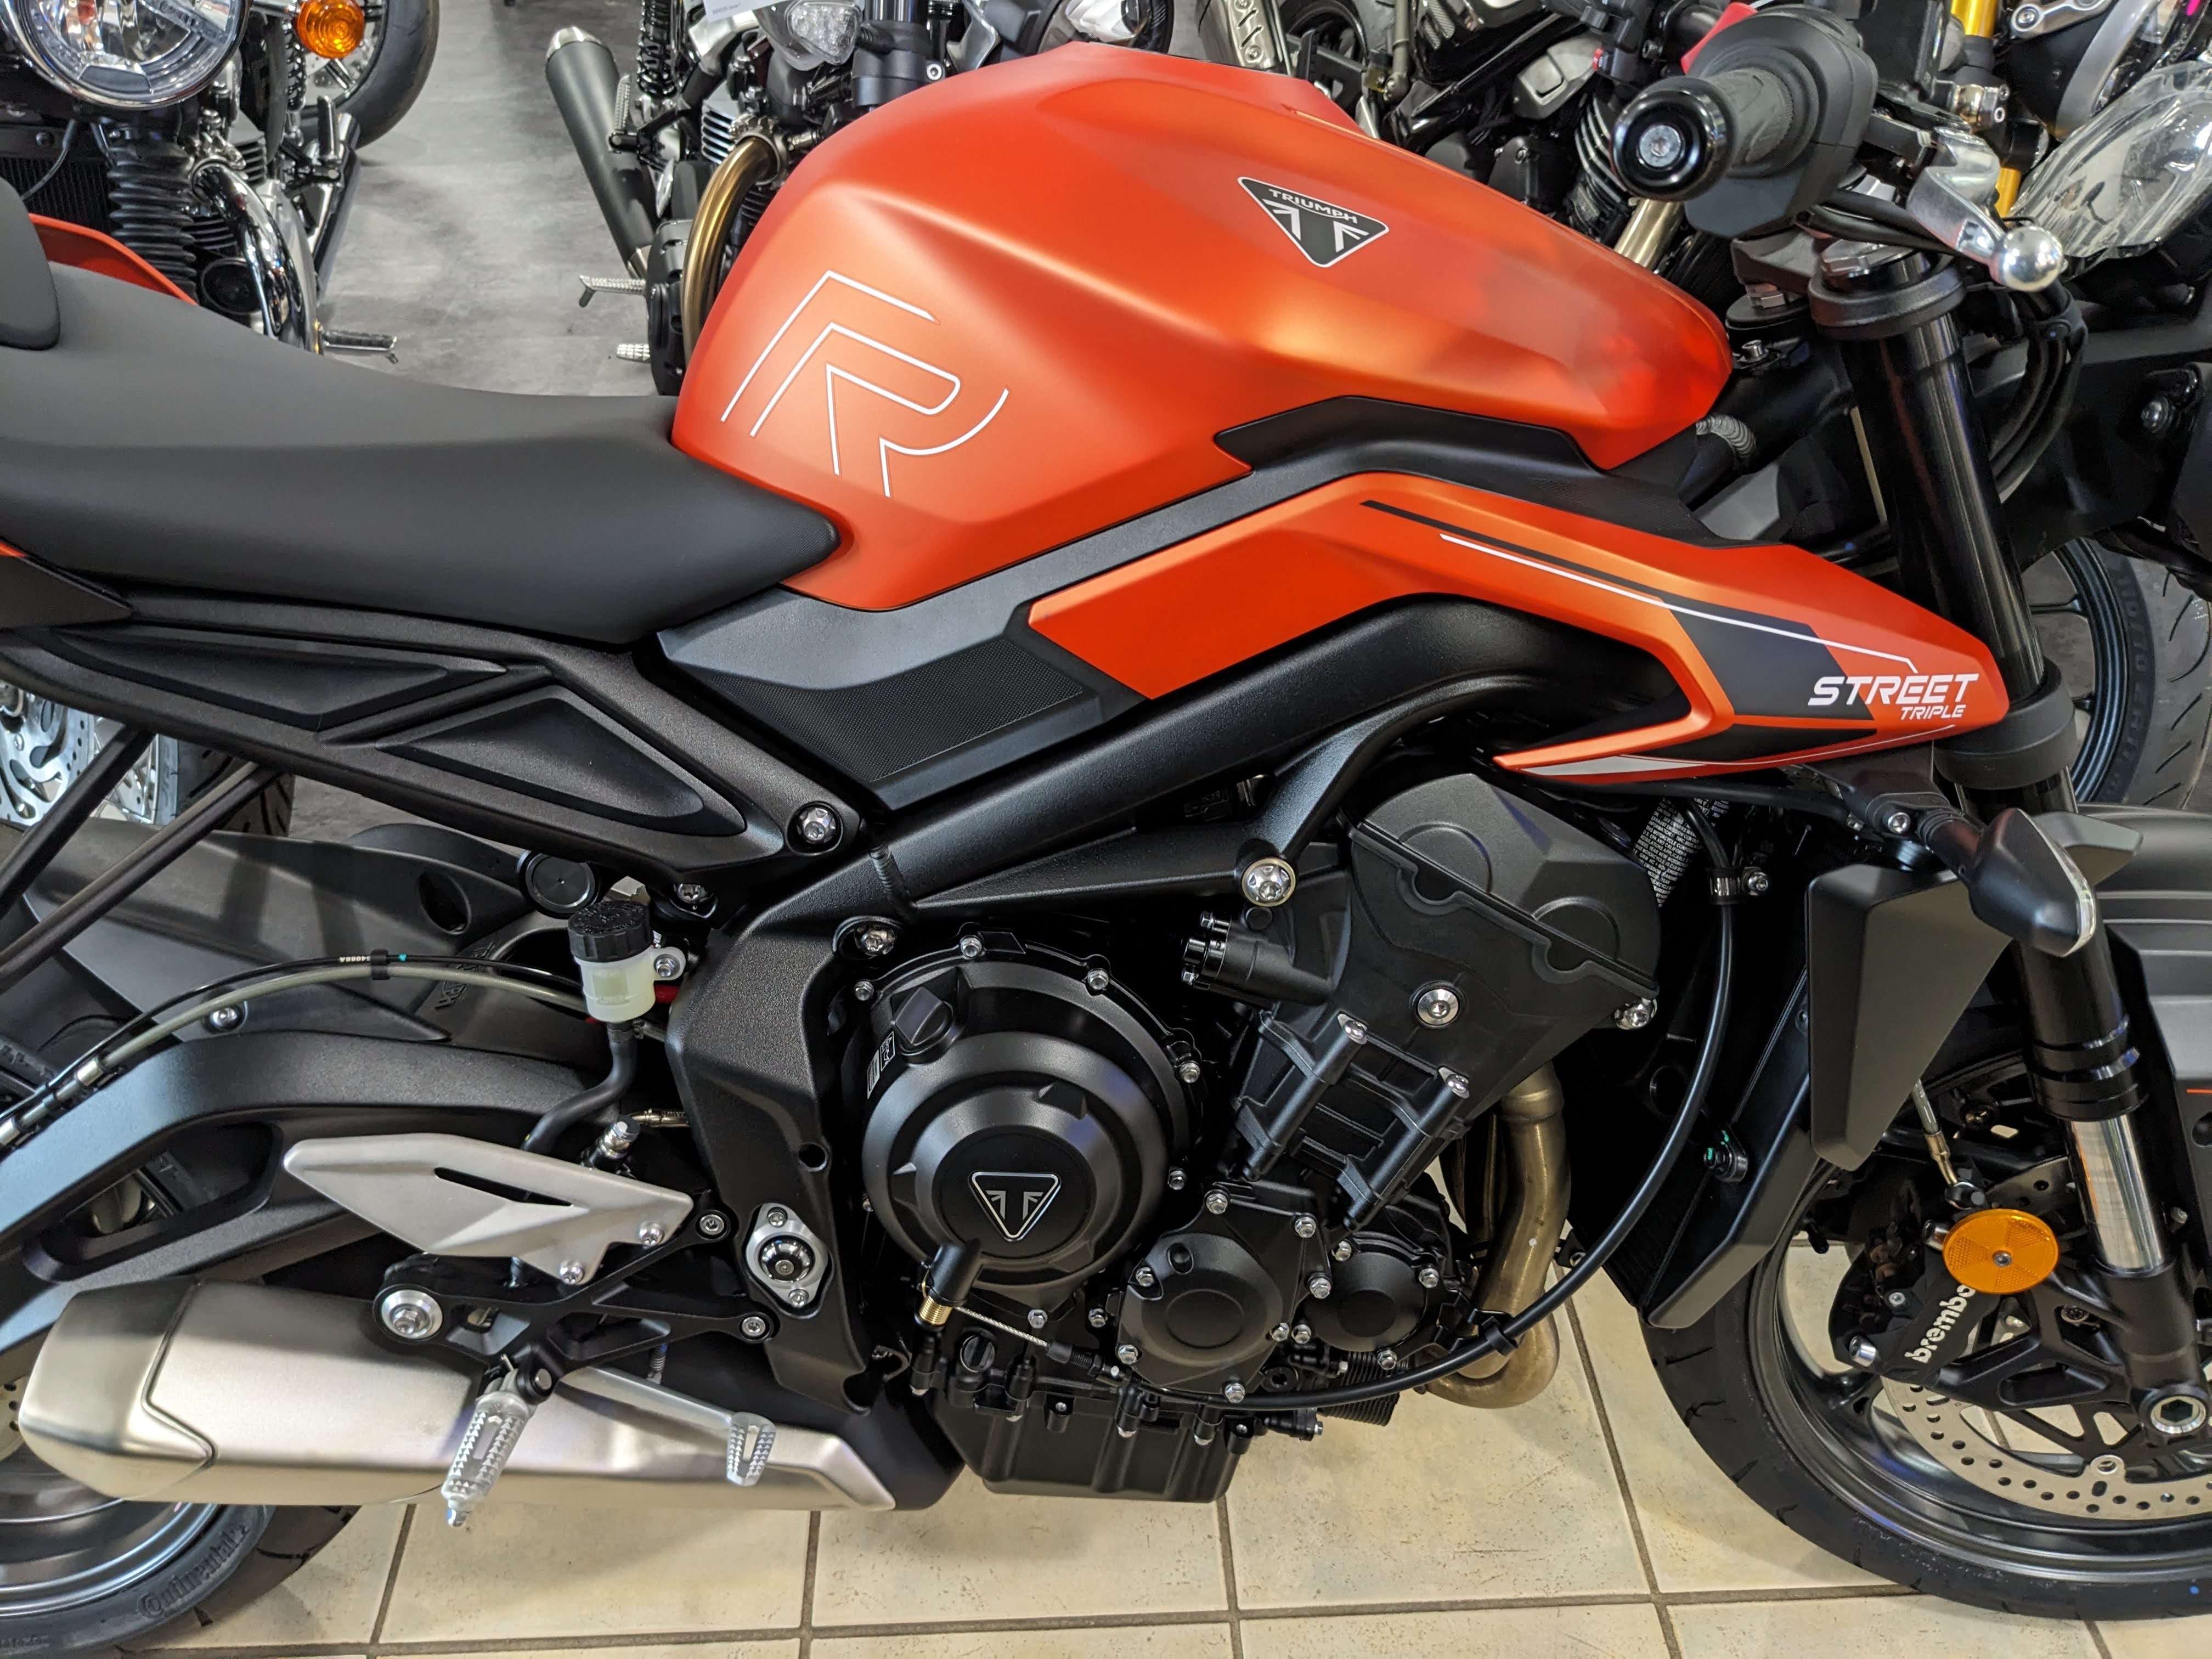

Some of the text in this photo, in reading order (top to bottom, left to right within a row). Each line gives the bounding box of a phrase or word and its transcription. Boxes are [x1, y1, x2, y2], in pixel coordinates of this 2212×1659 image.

[1268, 189, 1358, 223] TRIUMPH
[1807, 673, 1979, 706] STREET
[1901, 704, 1966, 720] TRIPLE
[1650, 815, 1667, 827] EXHAUST
[1666, 824, 1684, 837] EMISSION
[1639, 834, 1686, 862] REGULATIONS APPLICABLE
[1652, 829, 1678, 846] MOTORCYCLE
[1656, 837, 1666, 846] AND
[1664, 842, 1688, 857] CALIFORNIA
[1637, 839, 1650, 849] MODEL
[1648, 845, 1660, 855] YEAR
[1658, 851, 1668, 860] NEW
[1641, 848, 1667, 865] MOTORCYCLE
[1904, 1284, 1976, 1363] brembo
